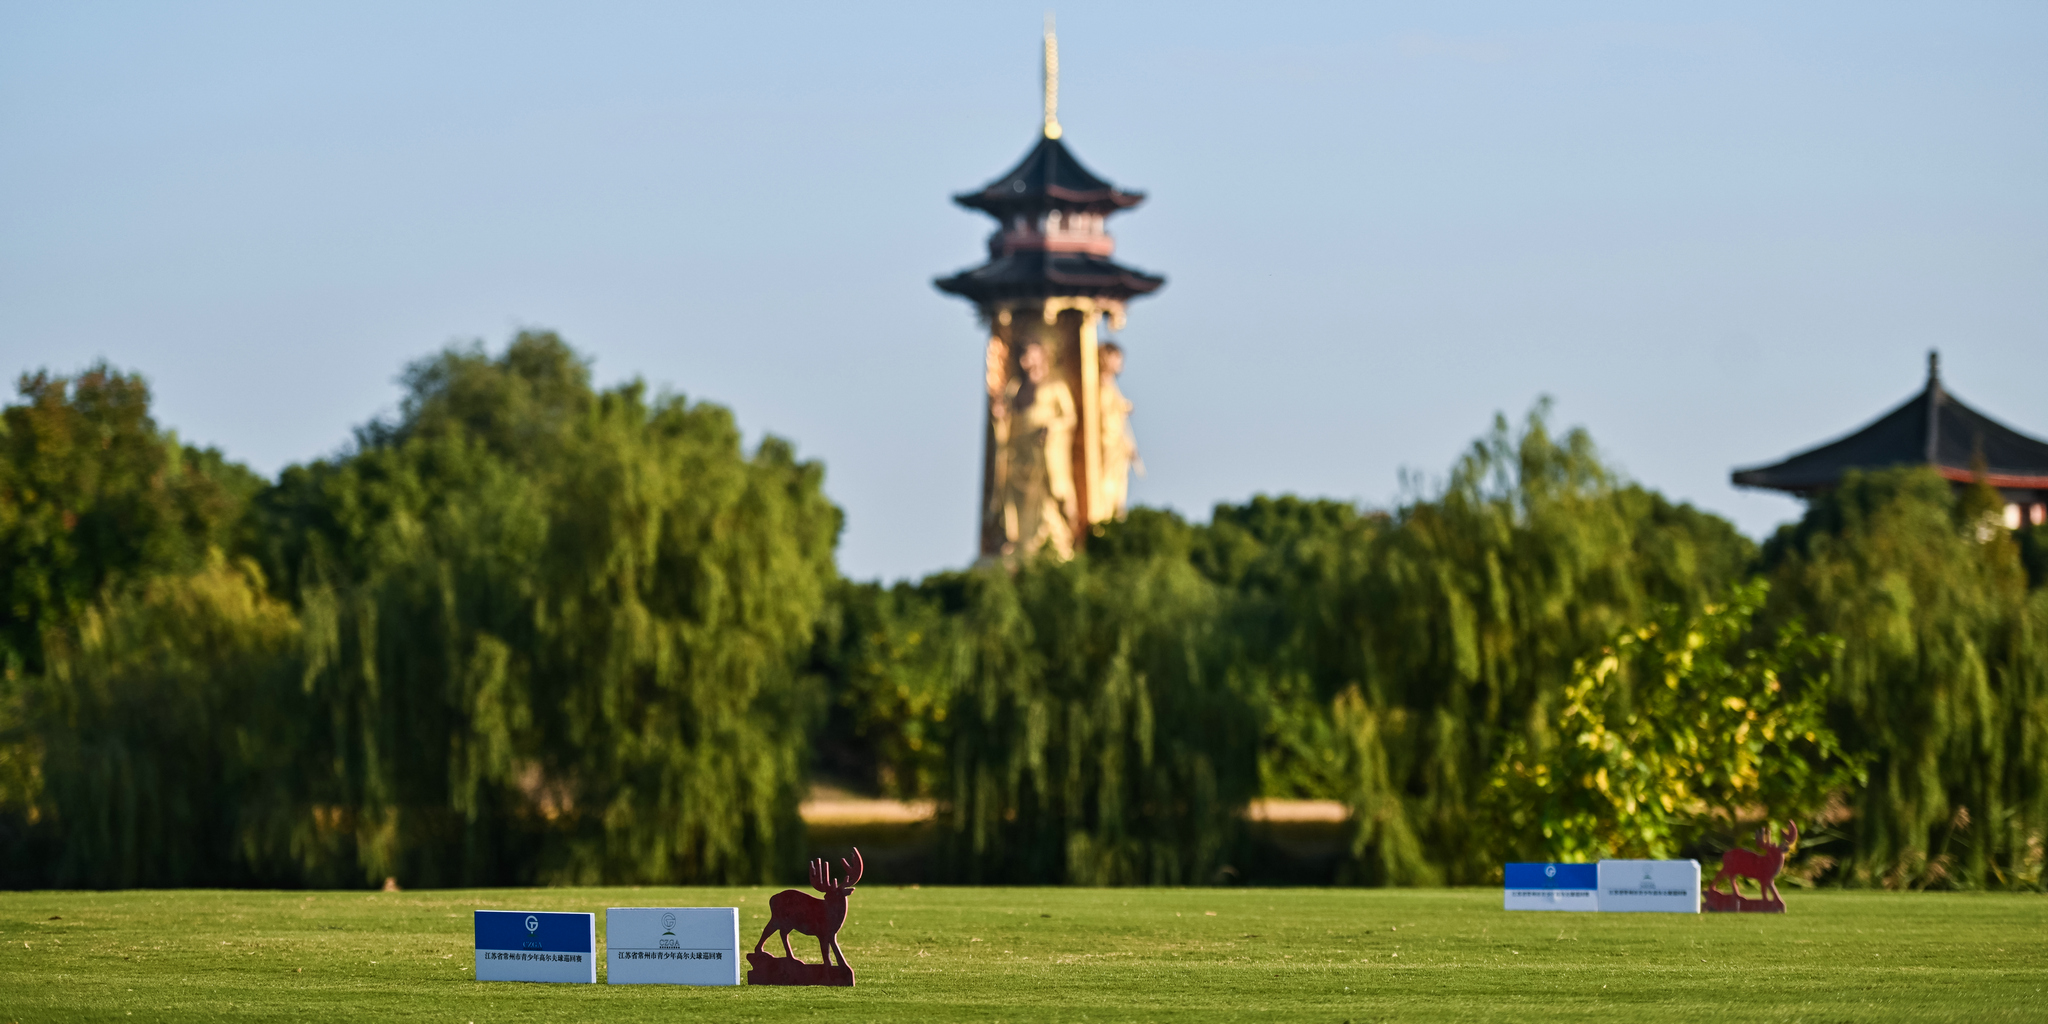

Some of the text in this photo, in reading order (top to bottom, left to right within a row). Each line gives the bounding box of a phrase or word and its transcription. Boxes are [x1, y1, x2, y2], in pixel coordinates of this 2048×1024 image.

[485, 952, 582, 963] 江苏省常州市青少年高尔夫球巡回赛
[618, 951, 722, 960] 江苏省常州市青少年高尔夫球巡回赛
